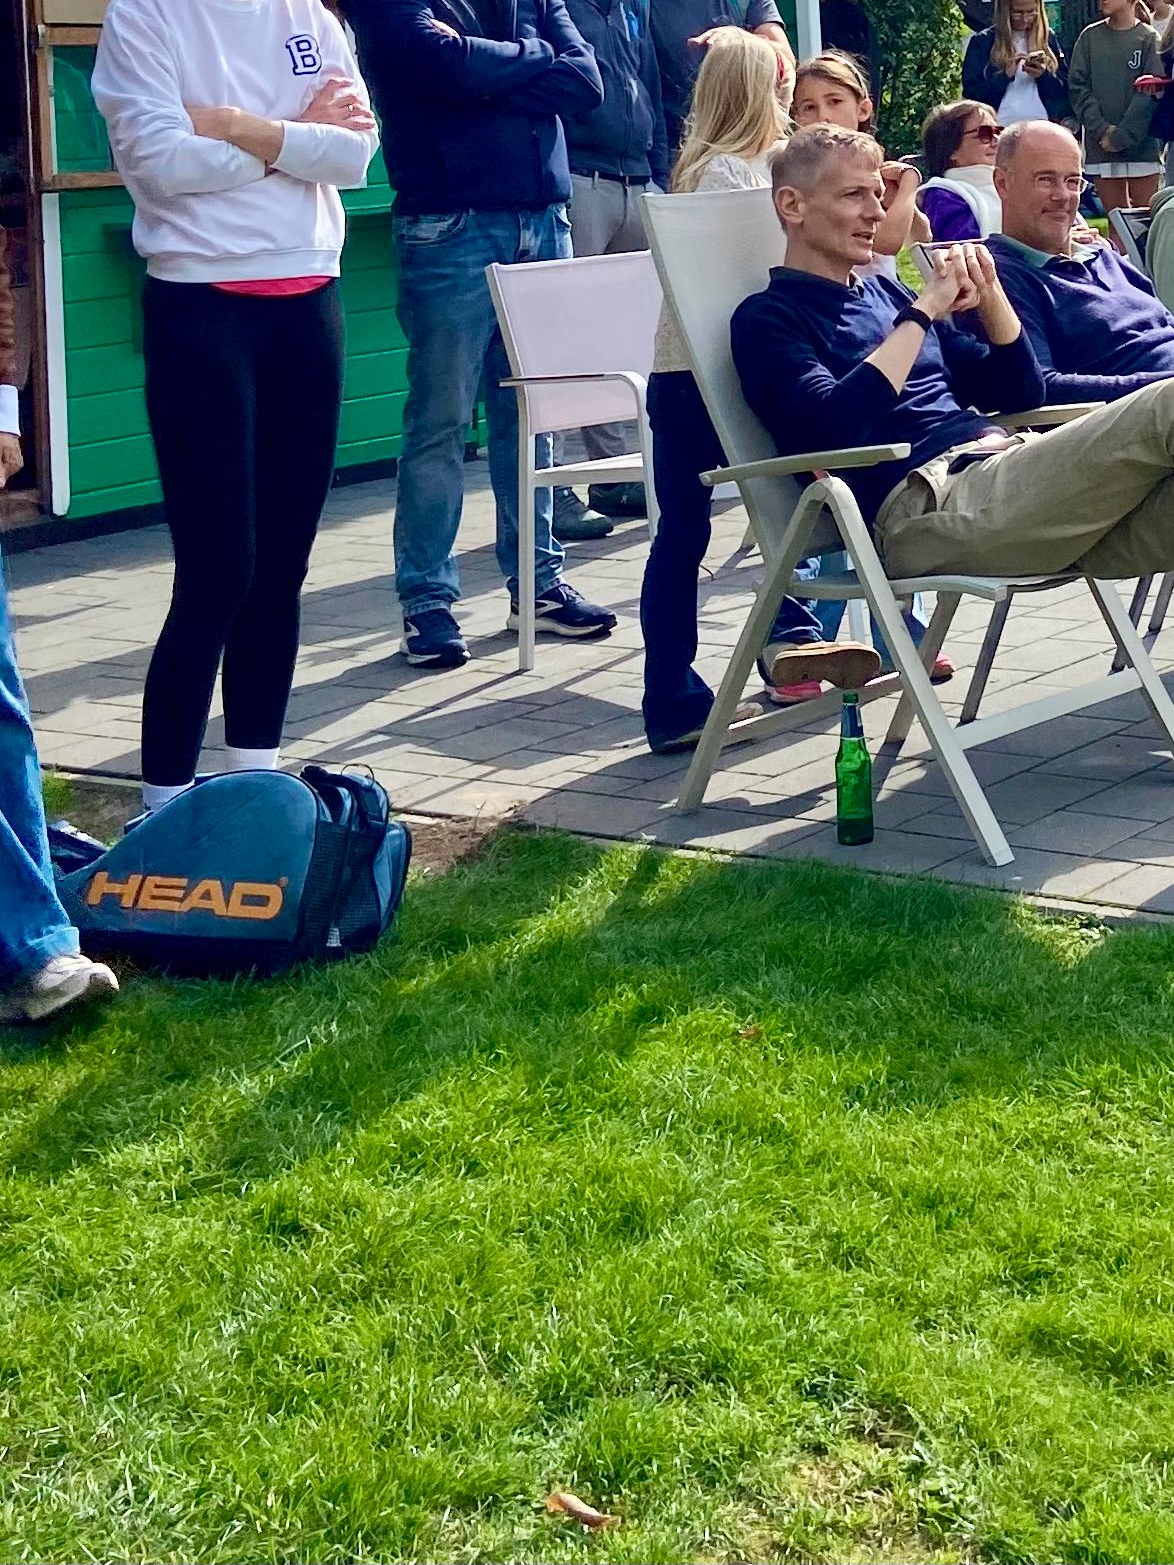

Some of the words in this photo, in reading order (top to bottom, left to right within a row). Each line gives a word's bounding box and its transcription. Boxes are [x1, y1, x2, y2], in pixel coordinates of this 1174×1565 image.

[285, 34, 322, 75] B
[1128, 50, 1141, 69] J
[87, 871, 283, 920] HEAD
